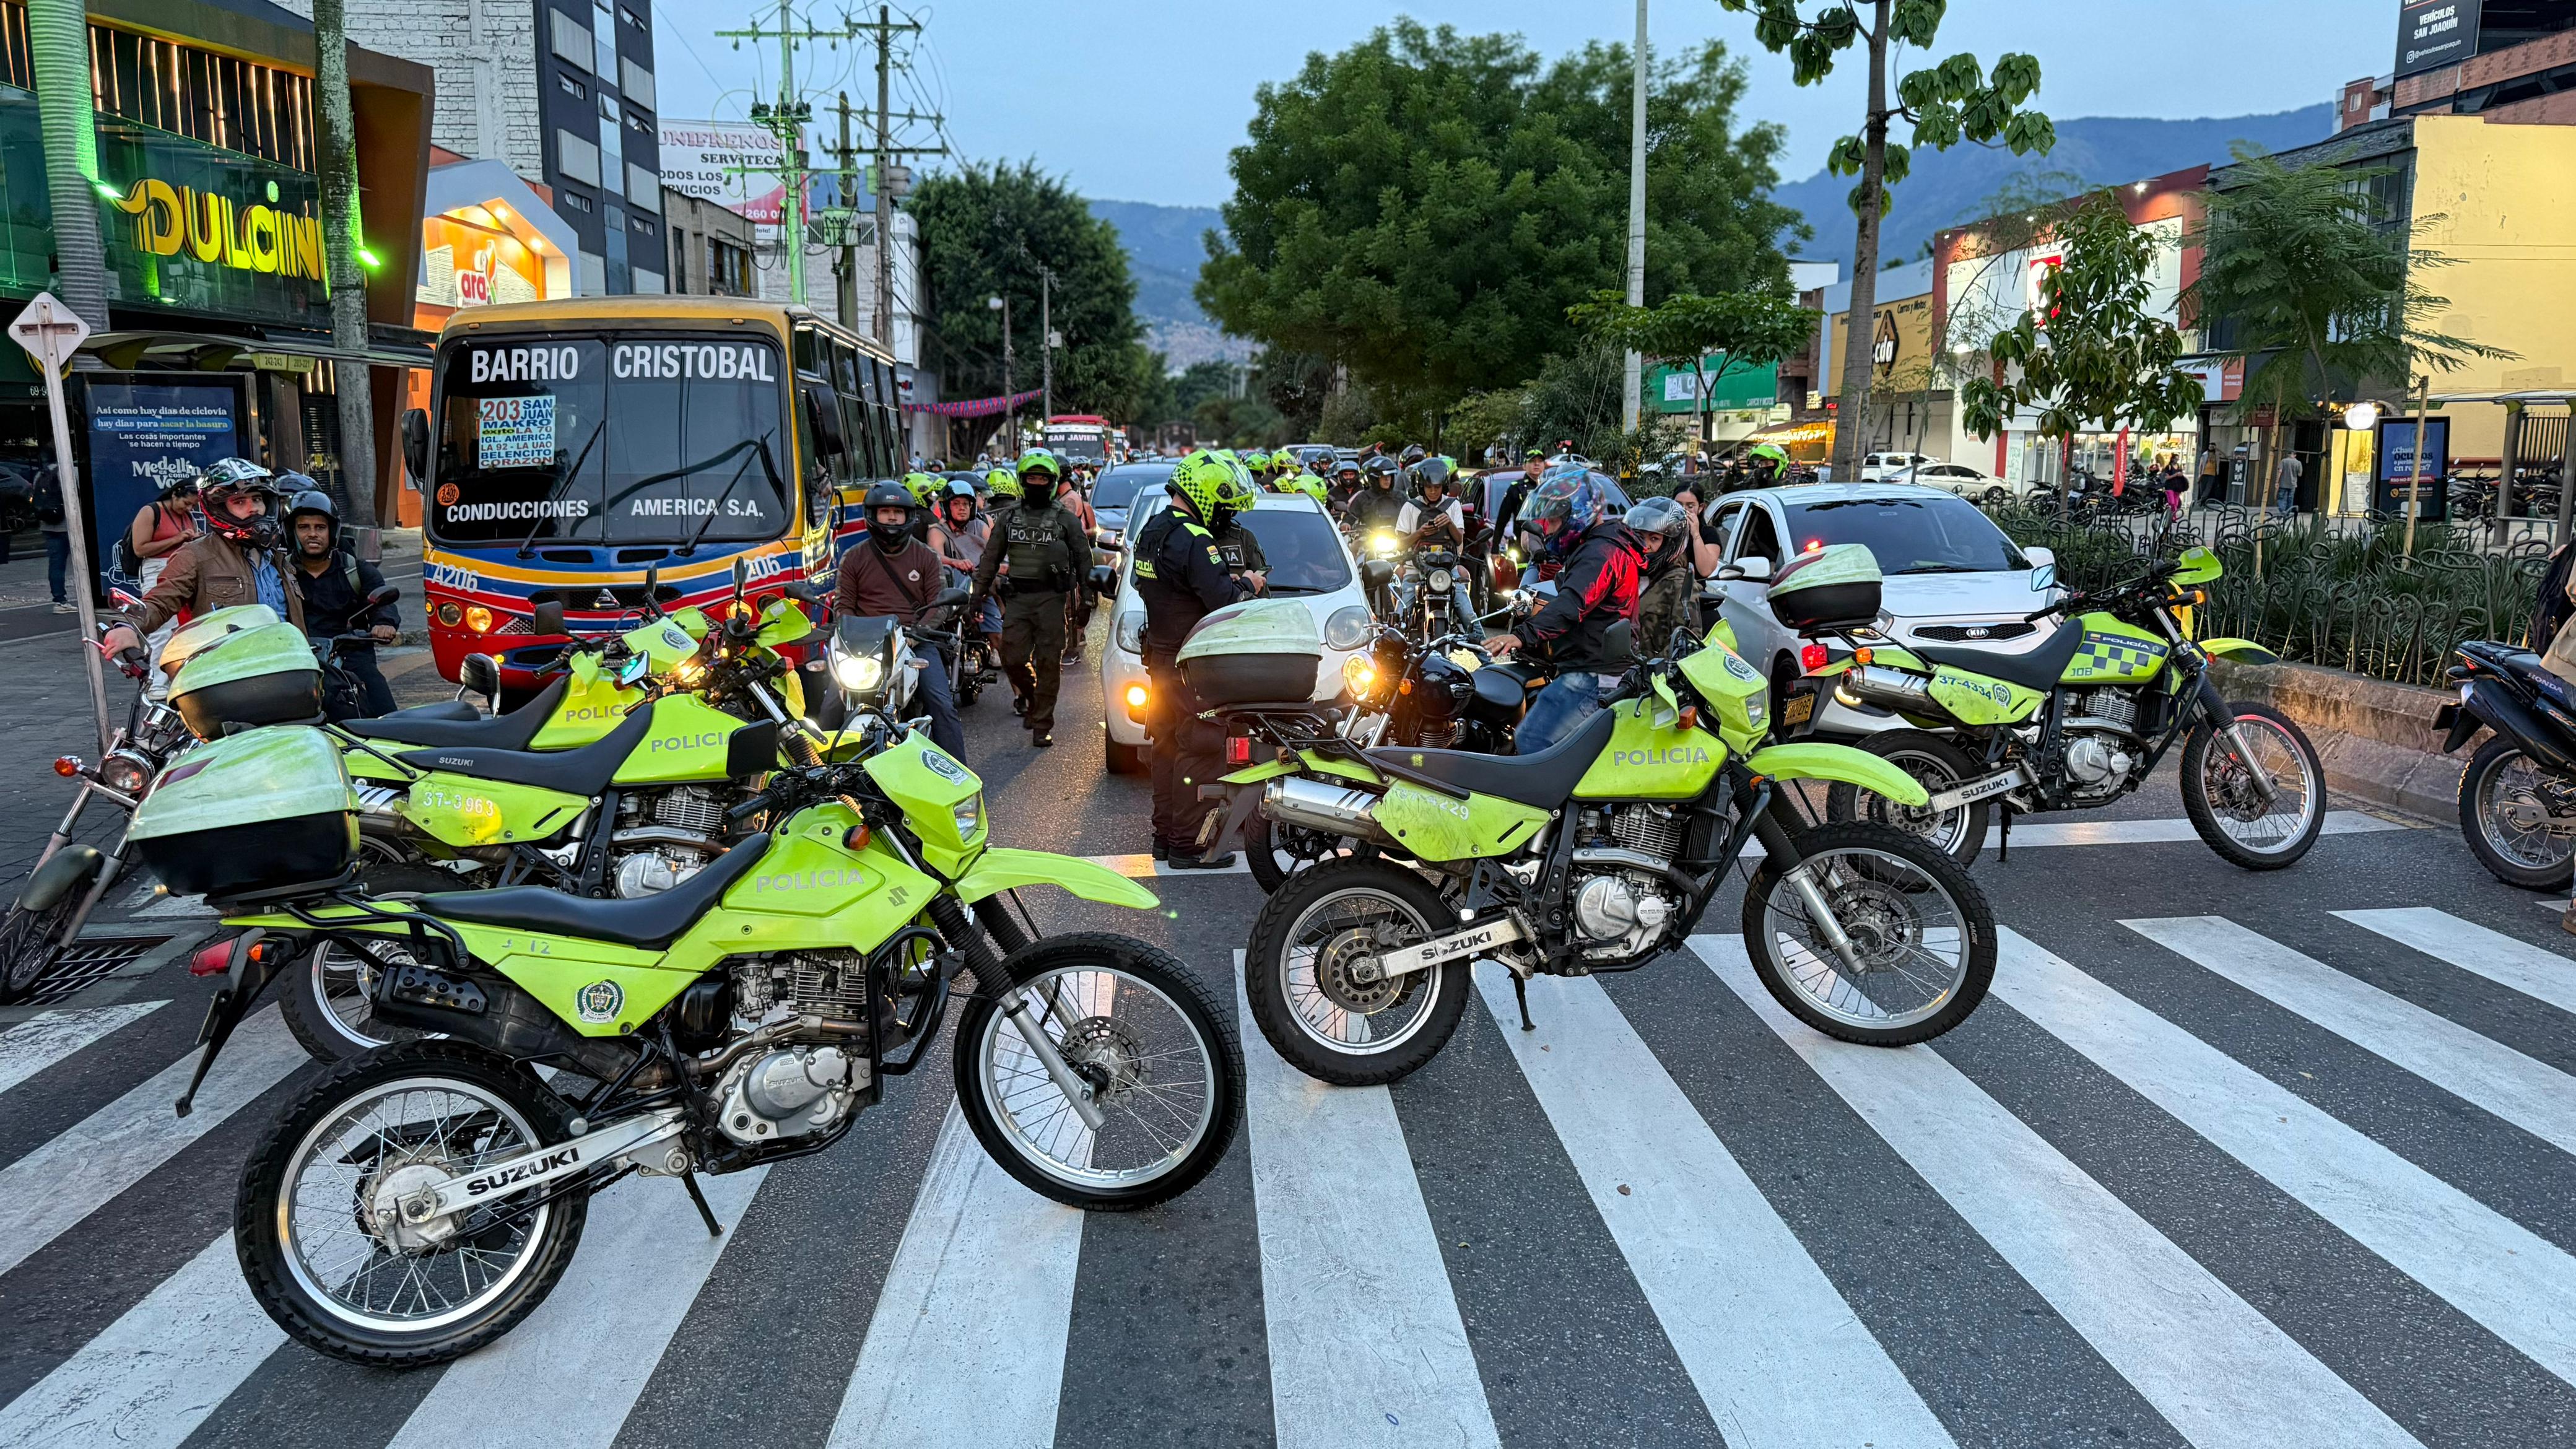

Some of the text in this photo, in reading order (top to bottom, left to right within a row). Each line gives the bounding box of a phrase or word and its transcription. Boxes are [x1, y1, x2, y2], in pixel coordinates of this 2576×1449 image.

[2419, 6, 2455, 25] VEHÍCULOS
[2414, 16, 2458, 40] SAN JOAQUÍN
[701, 153, 782, 165] SERVTECA
[659, 170, 723, 181] ODOS LOS
[746, 209, 767, 219] 260
[112, 179, 327, 281] DULCIN
[461, 273, 487, 301] ara
[471, 345, 775, 383] BARRIO CRISTOBAL
[96, 406, 111, 415] Así
[140, 406, 157, 417] hay
[159, 406, 178, 415] días
[179, 407, 190, 415] de
[191, 406, 227, 416] ciclovía
[483, 399, 553, 421] 203 SAN
[521, 409, 553, 420] JUAN
[98, 419, 113, 429] hay
[115, 419, 134, 428] días
[136, 421, 159, 429] para
[186, 419, 194, 428] la
[196, 420, 228, 429] basura
[483, 419, 551, 429] MAKRO
[159, 433, 206, 441] importantes
[505, 433, 552, 443] AMERICA
[481, 443, 494, 451] LA
[496, 443, 508, 451] 92
[481, 449, 552, 459] BELENCITO
[2394, 452, 2434, 461] ocuos
[132, 456, 202, 477] Medellín
[481, 456, 552, 467] CORAZON
[446, 498, 764, 523] CONDUCCIONES AMERICA S.A.
[432, 561, 479, 593] A206
[731, 553, 781, 583] 206
[1970, 629, 1986, 637] KIA
[2102, 636, 2150, 650] POLICÍA
[1939, 674, 1992, 700] 37-4334
[2527, 672, 2563, 694] HONDA
[566, 703, 627, 723] POLIC
[651, 731, 731, 753] POLICI
[439, 756, 474, 767] SUZUKI
[1613, 747, 1710, 767] POLICIA
[1960, 777, 2009, 799] SUZUKI
[423, 791, 494, 817] 37-3963
[756, 868, 864, 893] POLICIA
[769, 1076, 806, 1087] SUZUKI
[467, 1147, 580, 1196] SUZUKI
